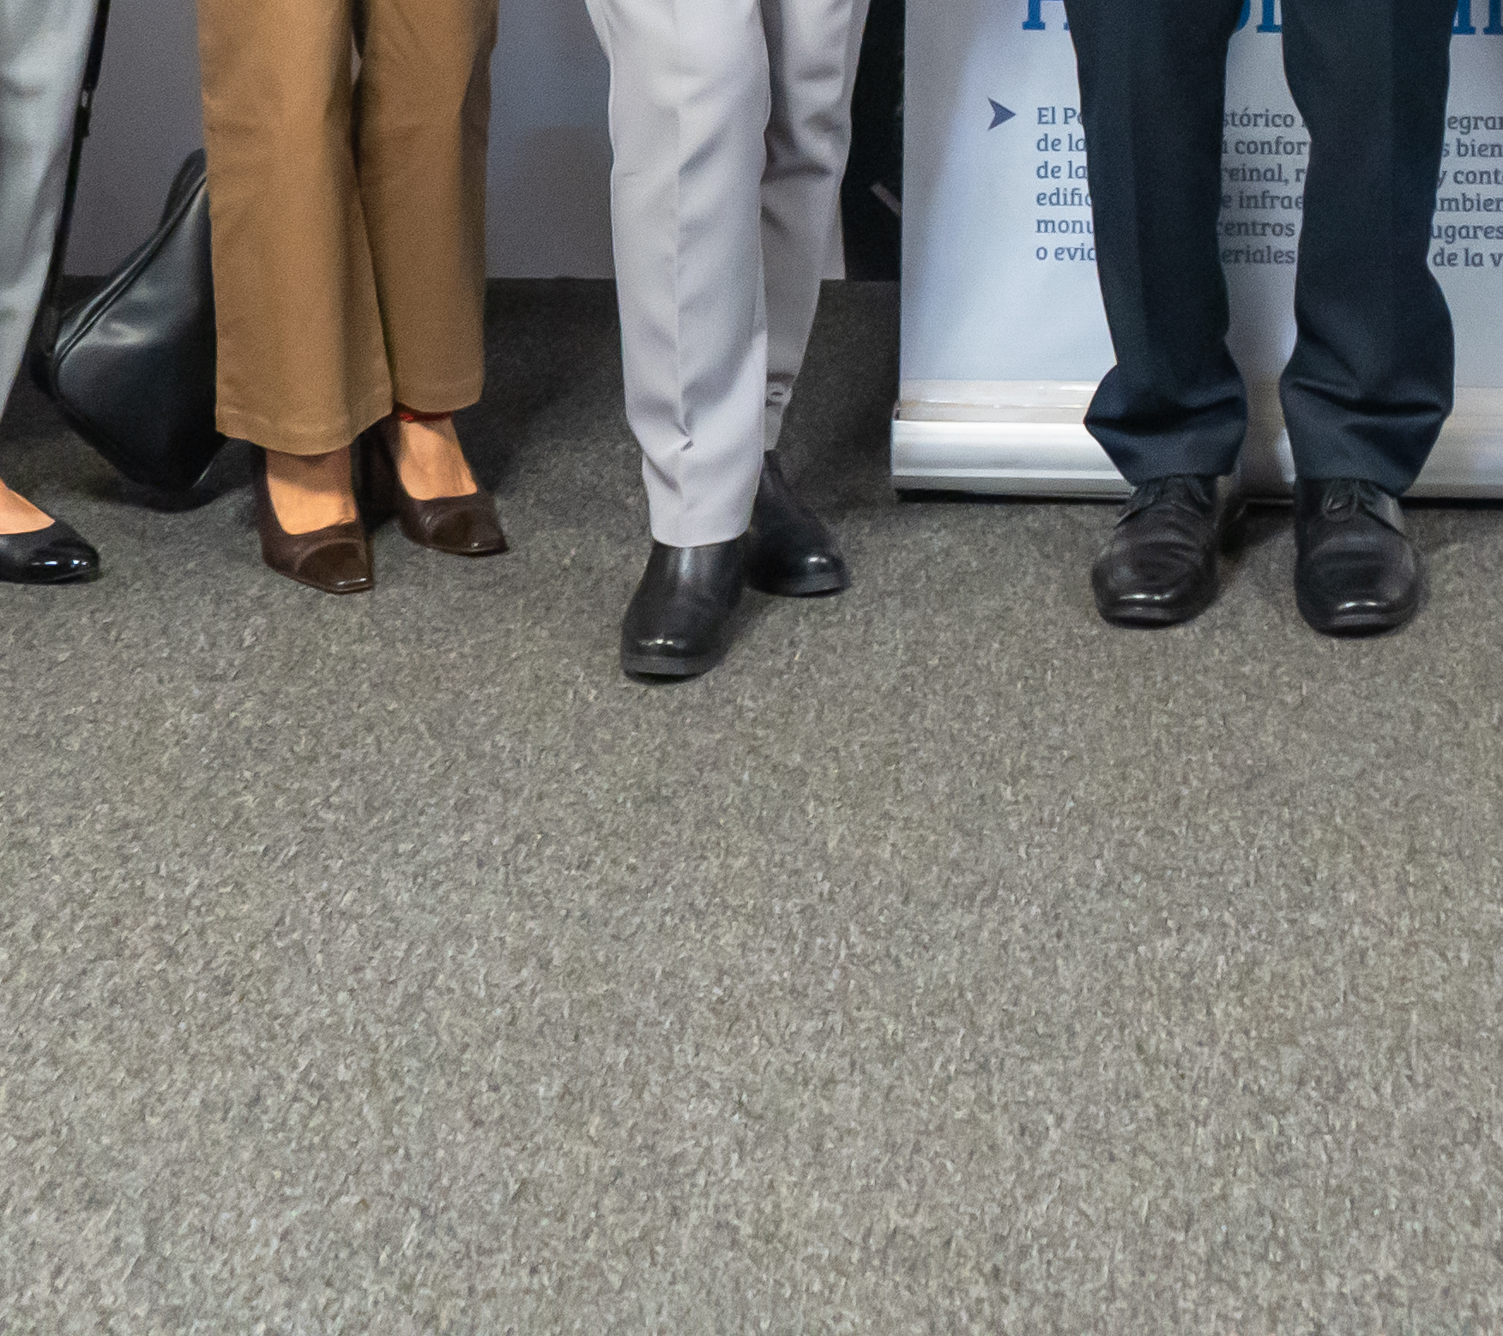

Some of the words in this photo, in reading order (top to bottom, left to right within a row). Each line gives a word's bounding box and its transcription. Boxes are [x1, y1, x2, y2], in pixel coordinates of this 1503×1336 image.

[1036, 106, 1057, 125] El
[1036, 133, 1062, 152] de
[1036, 160, 1062, 179] de
[1035, 246, 1048, 261] o
[1433, 248, 1458, 267] de
[1464, 248, 1484, 267] la
